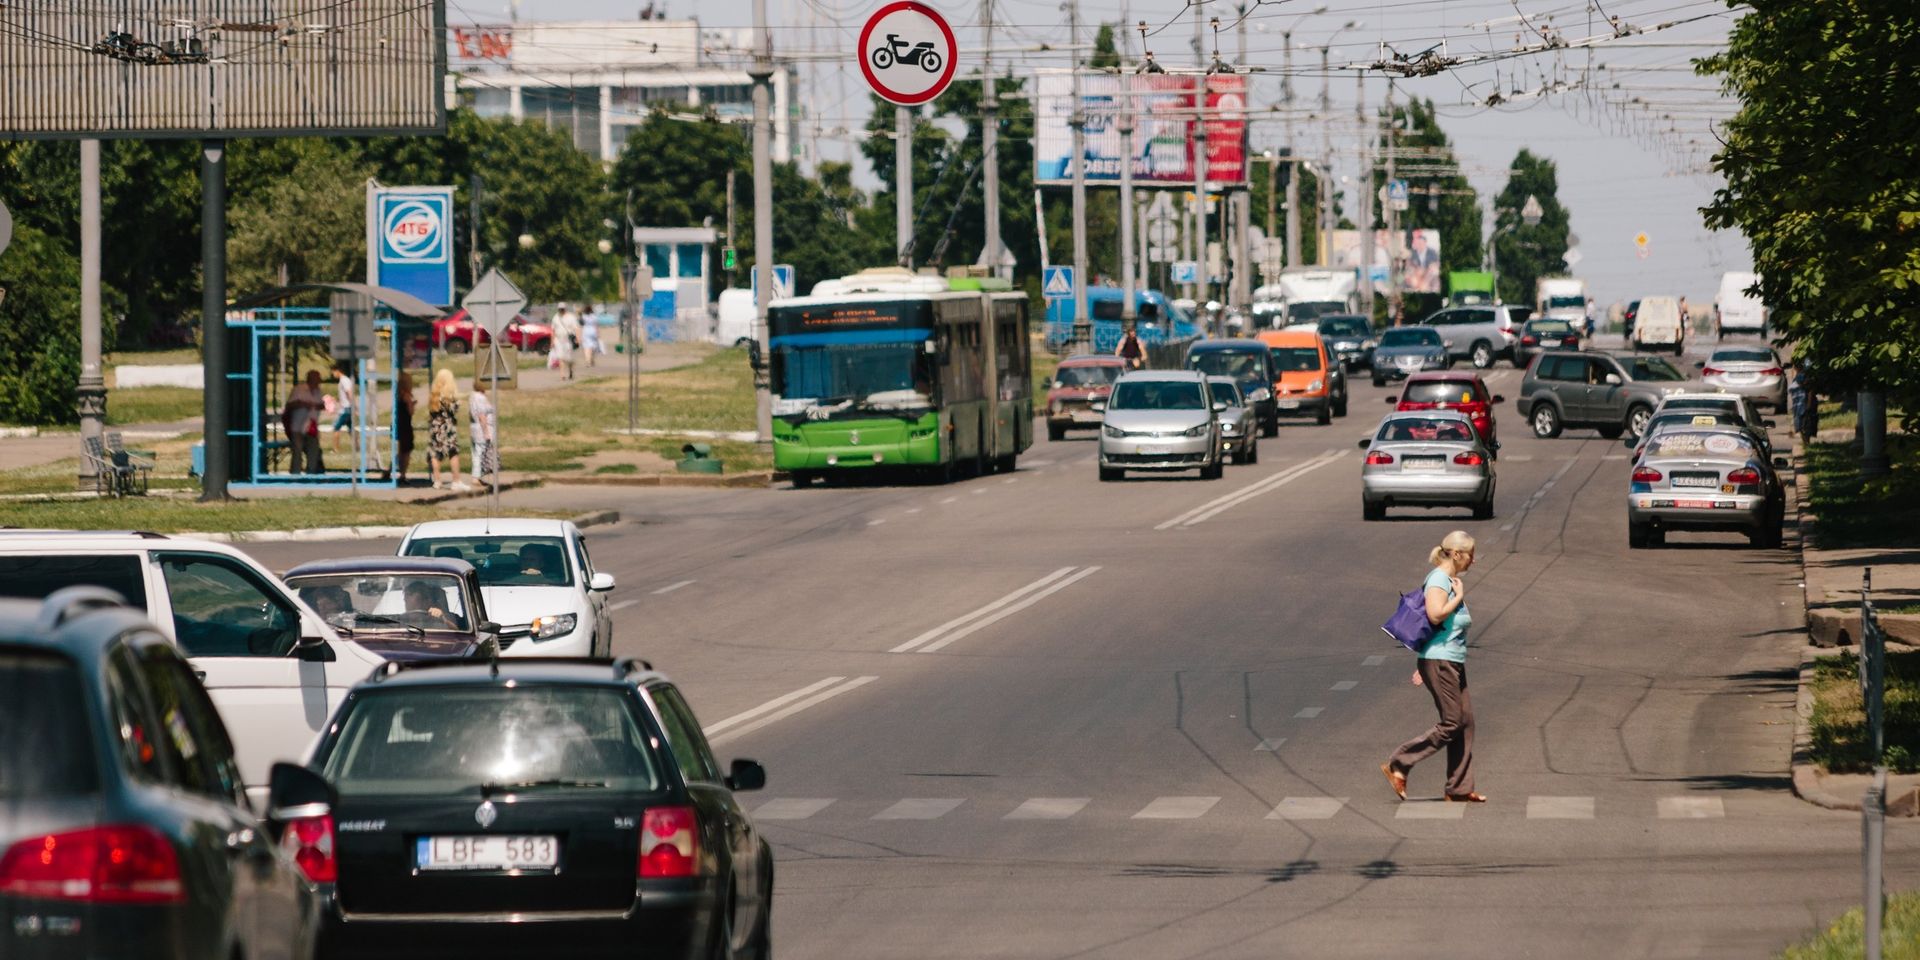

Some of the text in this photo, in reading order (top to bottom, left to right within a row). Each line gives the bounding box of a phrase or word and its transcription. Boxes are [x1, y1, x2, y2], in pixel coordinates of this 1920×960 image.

[394, 222, 429, 236] АТБ
[433, 837, 551, 863] LBF 583
